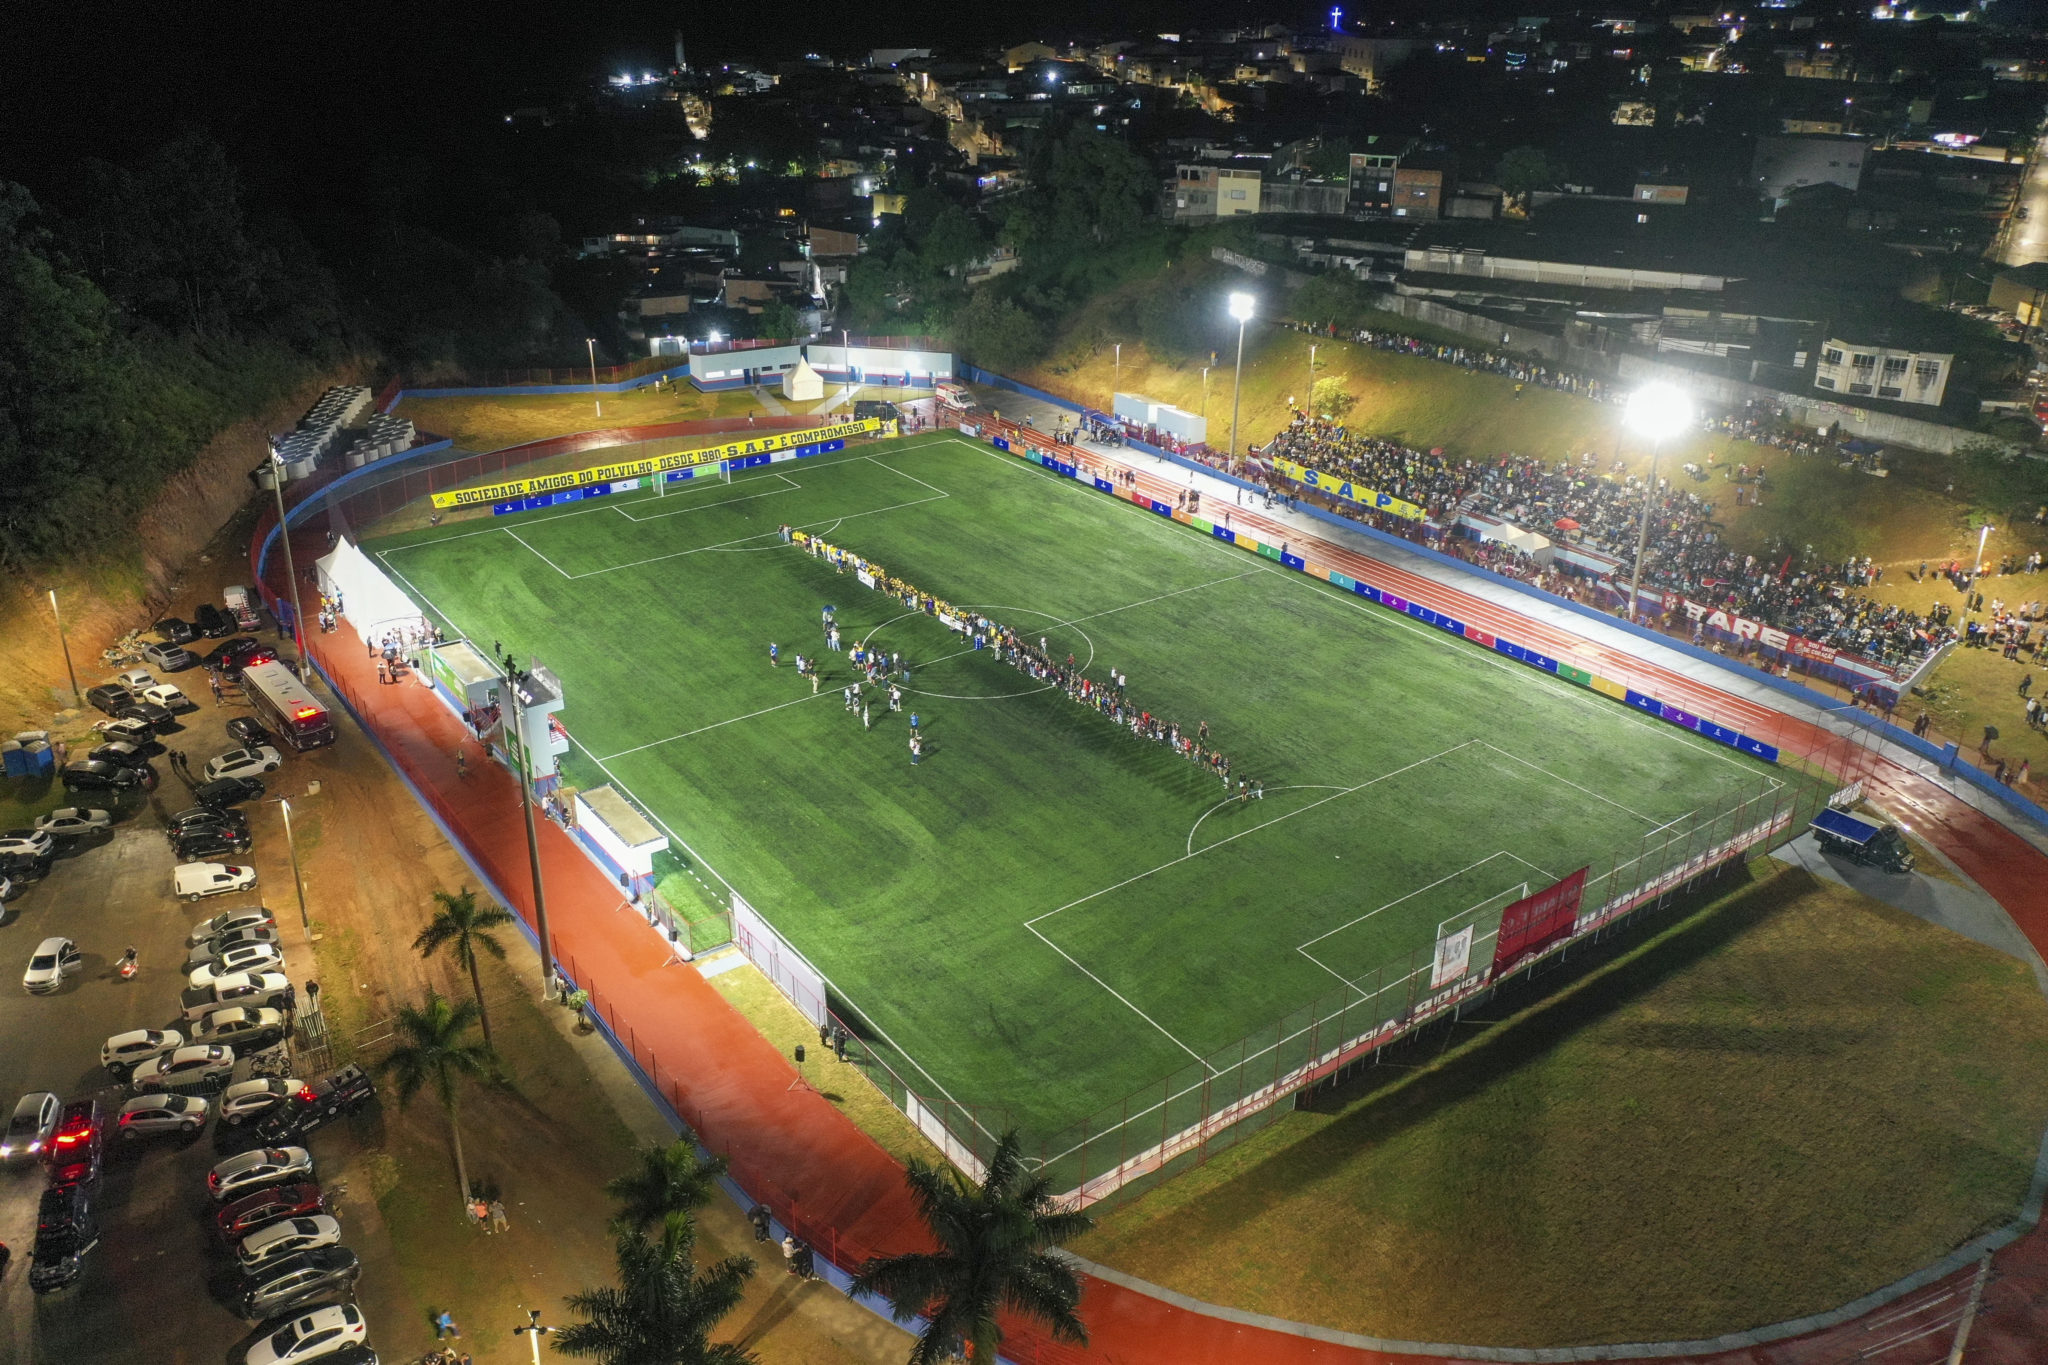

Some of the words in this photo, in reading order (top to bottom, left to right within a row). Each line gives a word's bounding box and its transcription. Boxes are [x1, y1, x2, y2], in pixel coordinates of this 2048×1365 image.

[455, 482, 524, 504] SOCIEDADE
[529, 474, 575, 492] AMIGOS
[579, 470, 593, 483] DO
[790, 422, 866, 445] COMPROMISSO
